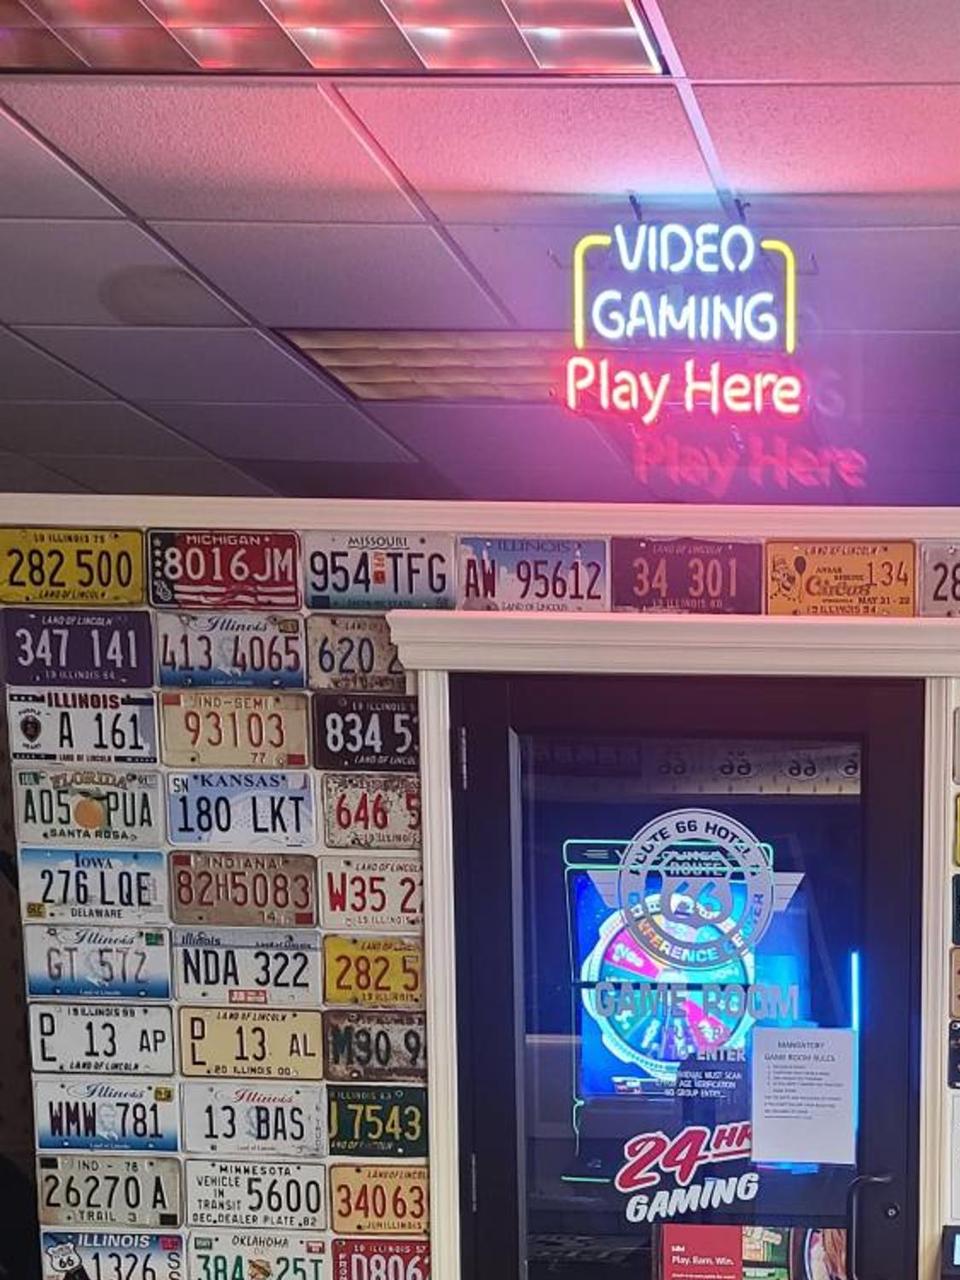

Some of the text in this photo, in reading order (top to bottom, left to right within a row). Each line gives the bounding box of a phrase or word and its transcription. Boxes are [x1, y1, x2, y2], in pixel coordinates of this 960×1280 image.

[615, 224, 754, 271] VIDEO
[592, 290, 778, 342] GAMING
[567, 357, 800, 424] Play Here
[186, 534, 259, 544] MICHIGAN
[348, 536, 409, 547] MISSOURI
[7, 549, 132, 588] 282 500
[310, 551, 446, 592] 954 TFG
[466, 559, 600, 599] AW 95612
[633, 557, 737, 598] 34 301
[205, 616, 268, 633] Illinois
[162, 634, 299, 673] 413 4065
[45, 692, 121, 708] ILLINOIS
[60, 713, 144, 750] A 161
[201, 775, 279, 788] KANSAS
[179, 797, 304, 832] 180 LKT
[676, 821, 698, 833] 66
[49, 829, 129, 841] SANTA ROSA
[207, 857, 279, 869] INDIANA
[40, 870, 150, 906] 276 LQE
[71, 908, 122, 919] DELAWARE
[75, 929, 134, 945] Illinois
[183, 951, 308, 988] NDA 322
[595, 981, 799, 1020] GAME ROOM
[235, 1025, 316, 1061] 13 AL
[697, 1050, 746, 1062] ENTER
[49, 1103, 163, 1138] WMW 781
[219, 1165, 291, 1176] MINNESOTA
[615, 1126, 710, 1192] 24
[197, 1176, 240, 1188] VEHICLE
[247, 1178, 320, 1213] 5600
[625, 1173, 759, 1222] GAMING
[78, 1212, 116, 1222] TRAIL
[198, 1199, 240, 1210] TRANSIT
[77, 1235, 149, 1248] ILLINOIS
[232, 1236, 288, 1247] OKLAHOMA
